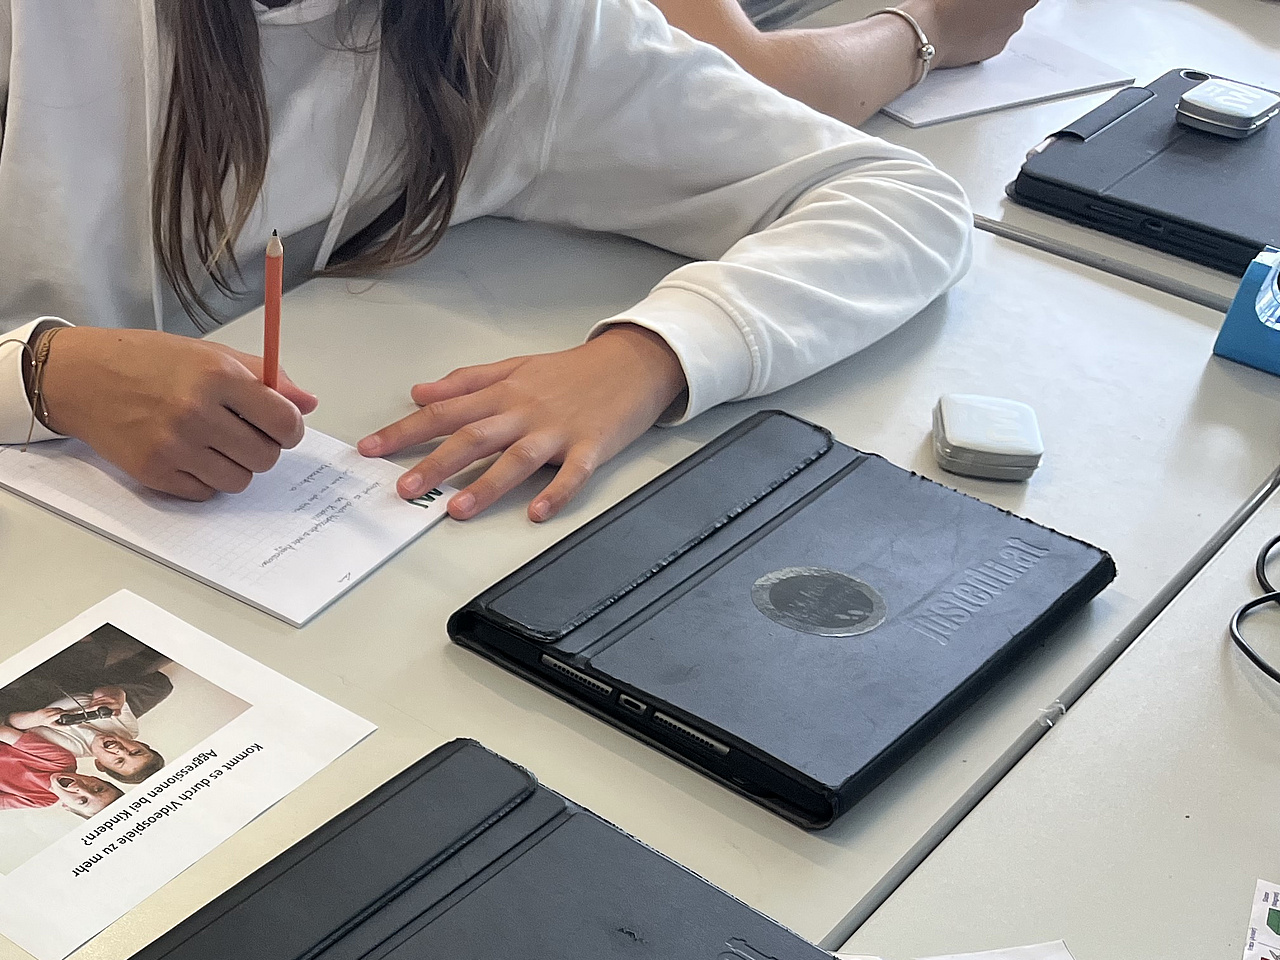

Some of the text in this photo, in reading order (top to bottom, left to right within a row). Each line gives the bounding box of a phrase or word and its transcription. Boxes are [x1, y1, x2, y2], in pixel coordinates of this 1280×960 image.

[71, 743, 265, 878] Kommt es durch Videospiele zu mehr
[80, 748, 218, 846] Aggressionen bei Kindern?
